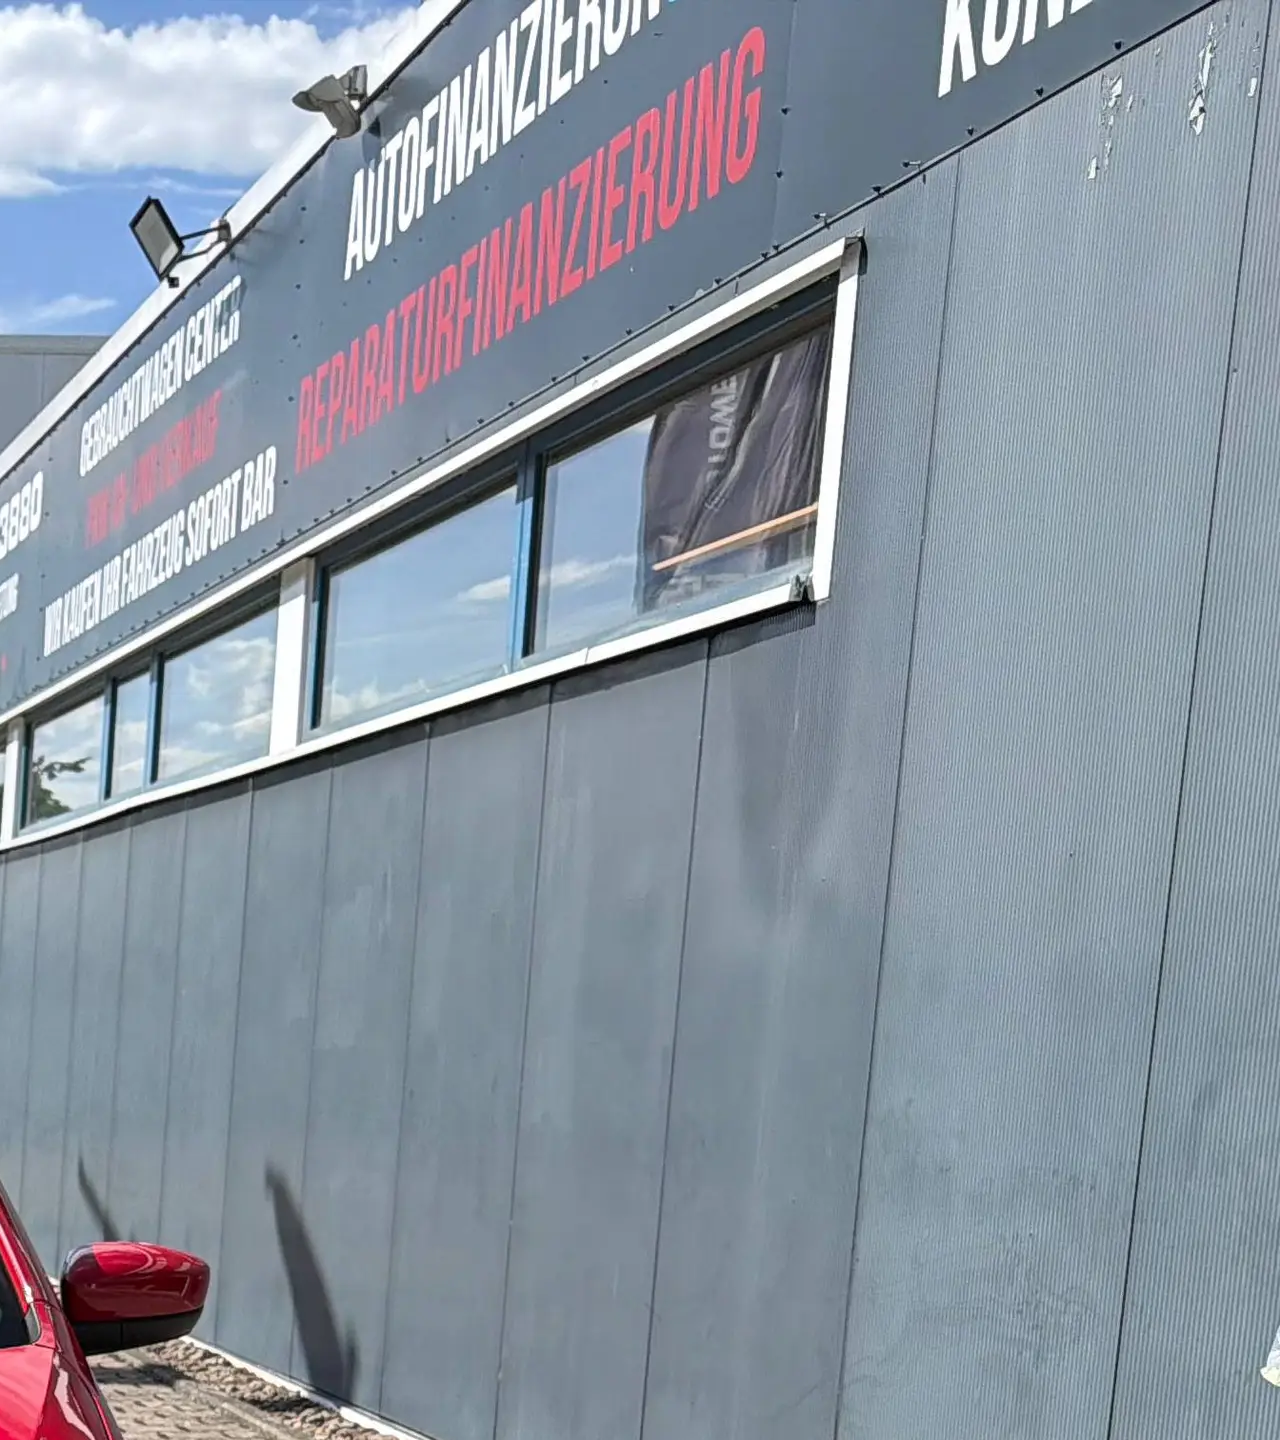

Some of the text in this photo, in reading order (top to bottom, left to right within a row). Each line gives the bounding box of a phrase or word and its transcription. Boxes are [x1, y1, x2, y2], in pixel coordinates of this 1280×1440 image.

[295, 27, 766, 475] REPARATURFINANZIERUNG
[344, 0, 678, 280] AUTOFINANZIERU
[79, 274, 241, 477] GEBRAUCHTWAGEN CENTER
[44, 597, 62, 657] WIR
[62, 569, 101, 647] KAUFEN
[101, 556, 120, 623] IHR
[120, 511, 185, 609] FAHRZEUG
[185, 469, 241, 566] SOFORT
[241, 445, 277, 532] BAR
